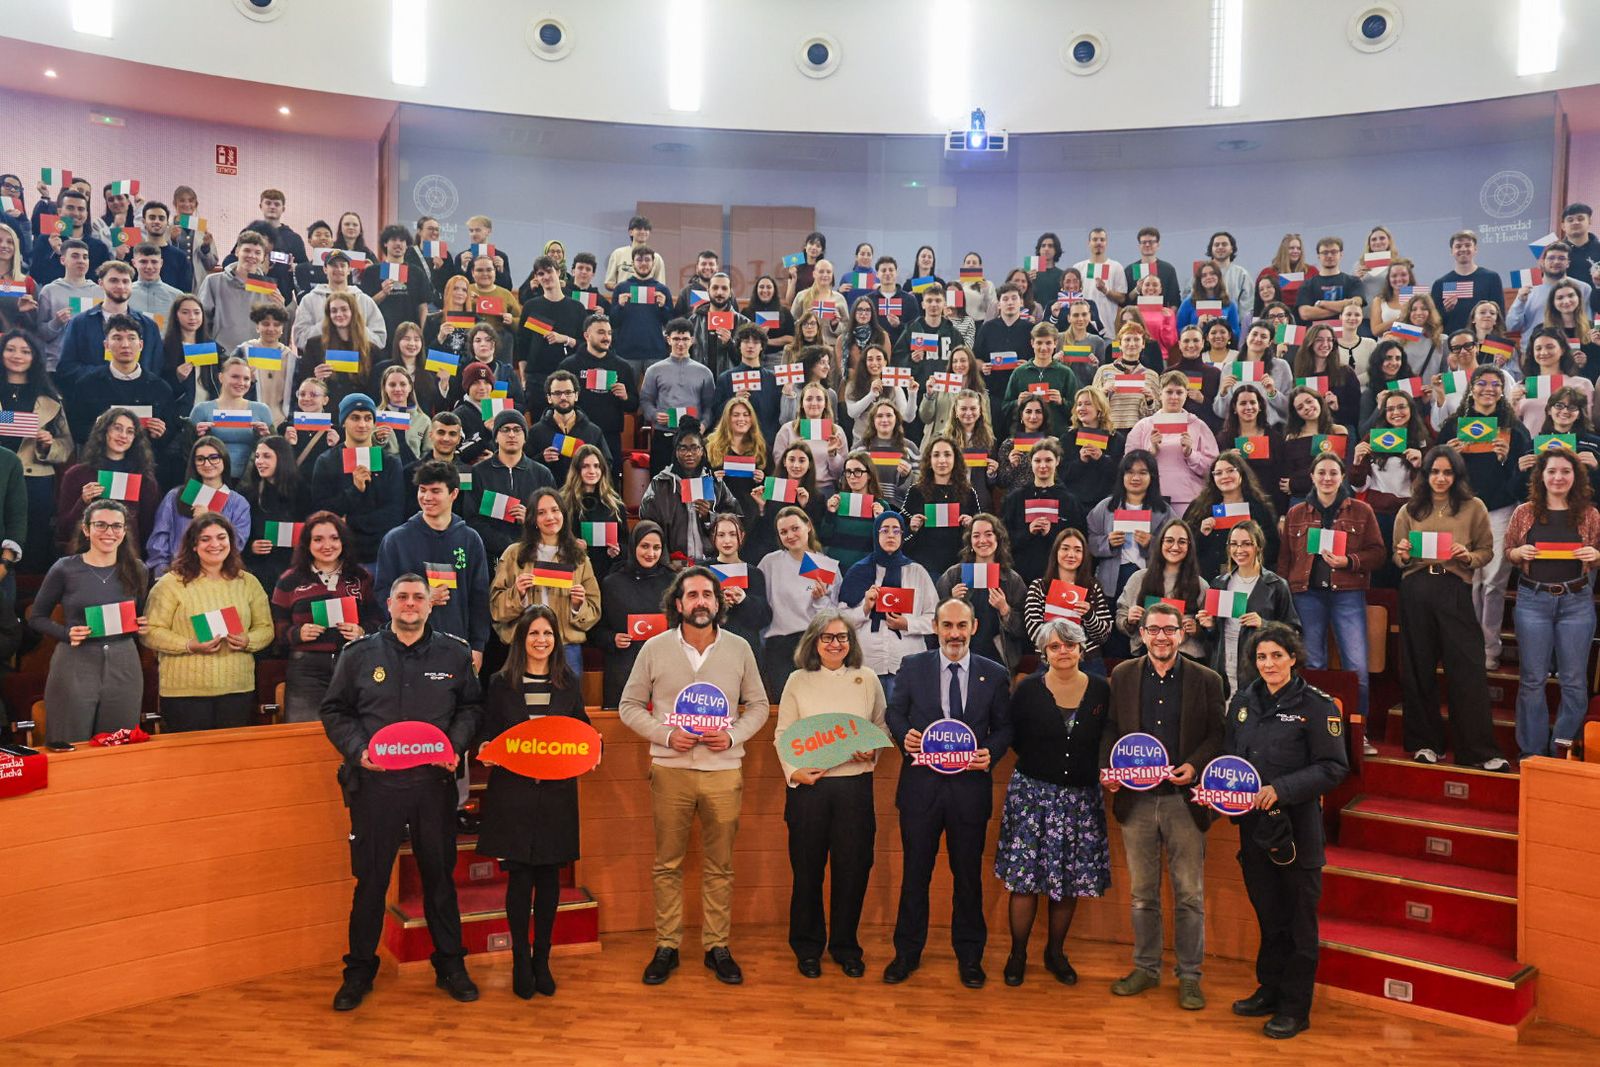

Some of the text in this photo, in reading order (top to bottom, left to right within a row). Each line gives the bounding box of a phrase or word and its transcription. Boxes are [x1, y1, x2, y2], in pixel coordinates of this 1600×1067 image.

[1479, 219, 1531, 233] Universidad
[1496, 231, 1528, 243] Huelva
[682, 691, 725, 708] HUELVA
[669, 713, 729, 729] ERASMUS
[927, 731, 971, 744] HUELVA
[374, 741, 445, 756] Welcome
[506, 738, 590, 755] Welcome
[1117, 745, 1162, 758] HUELVA
[1107, 766, 1170, 782] ERASMUS
[1209, 766, 1255, 785] HUELVA
[1197, 788, 1253, 805] ERASMU
